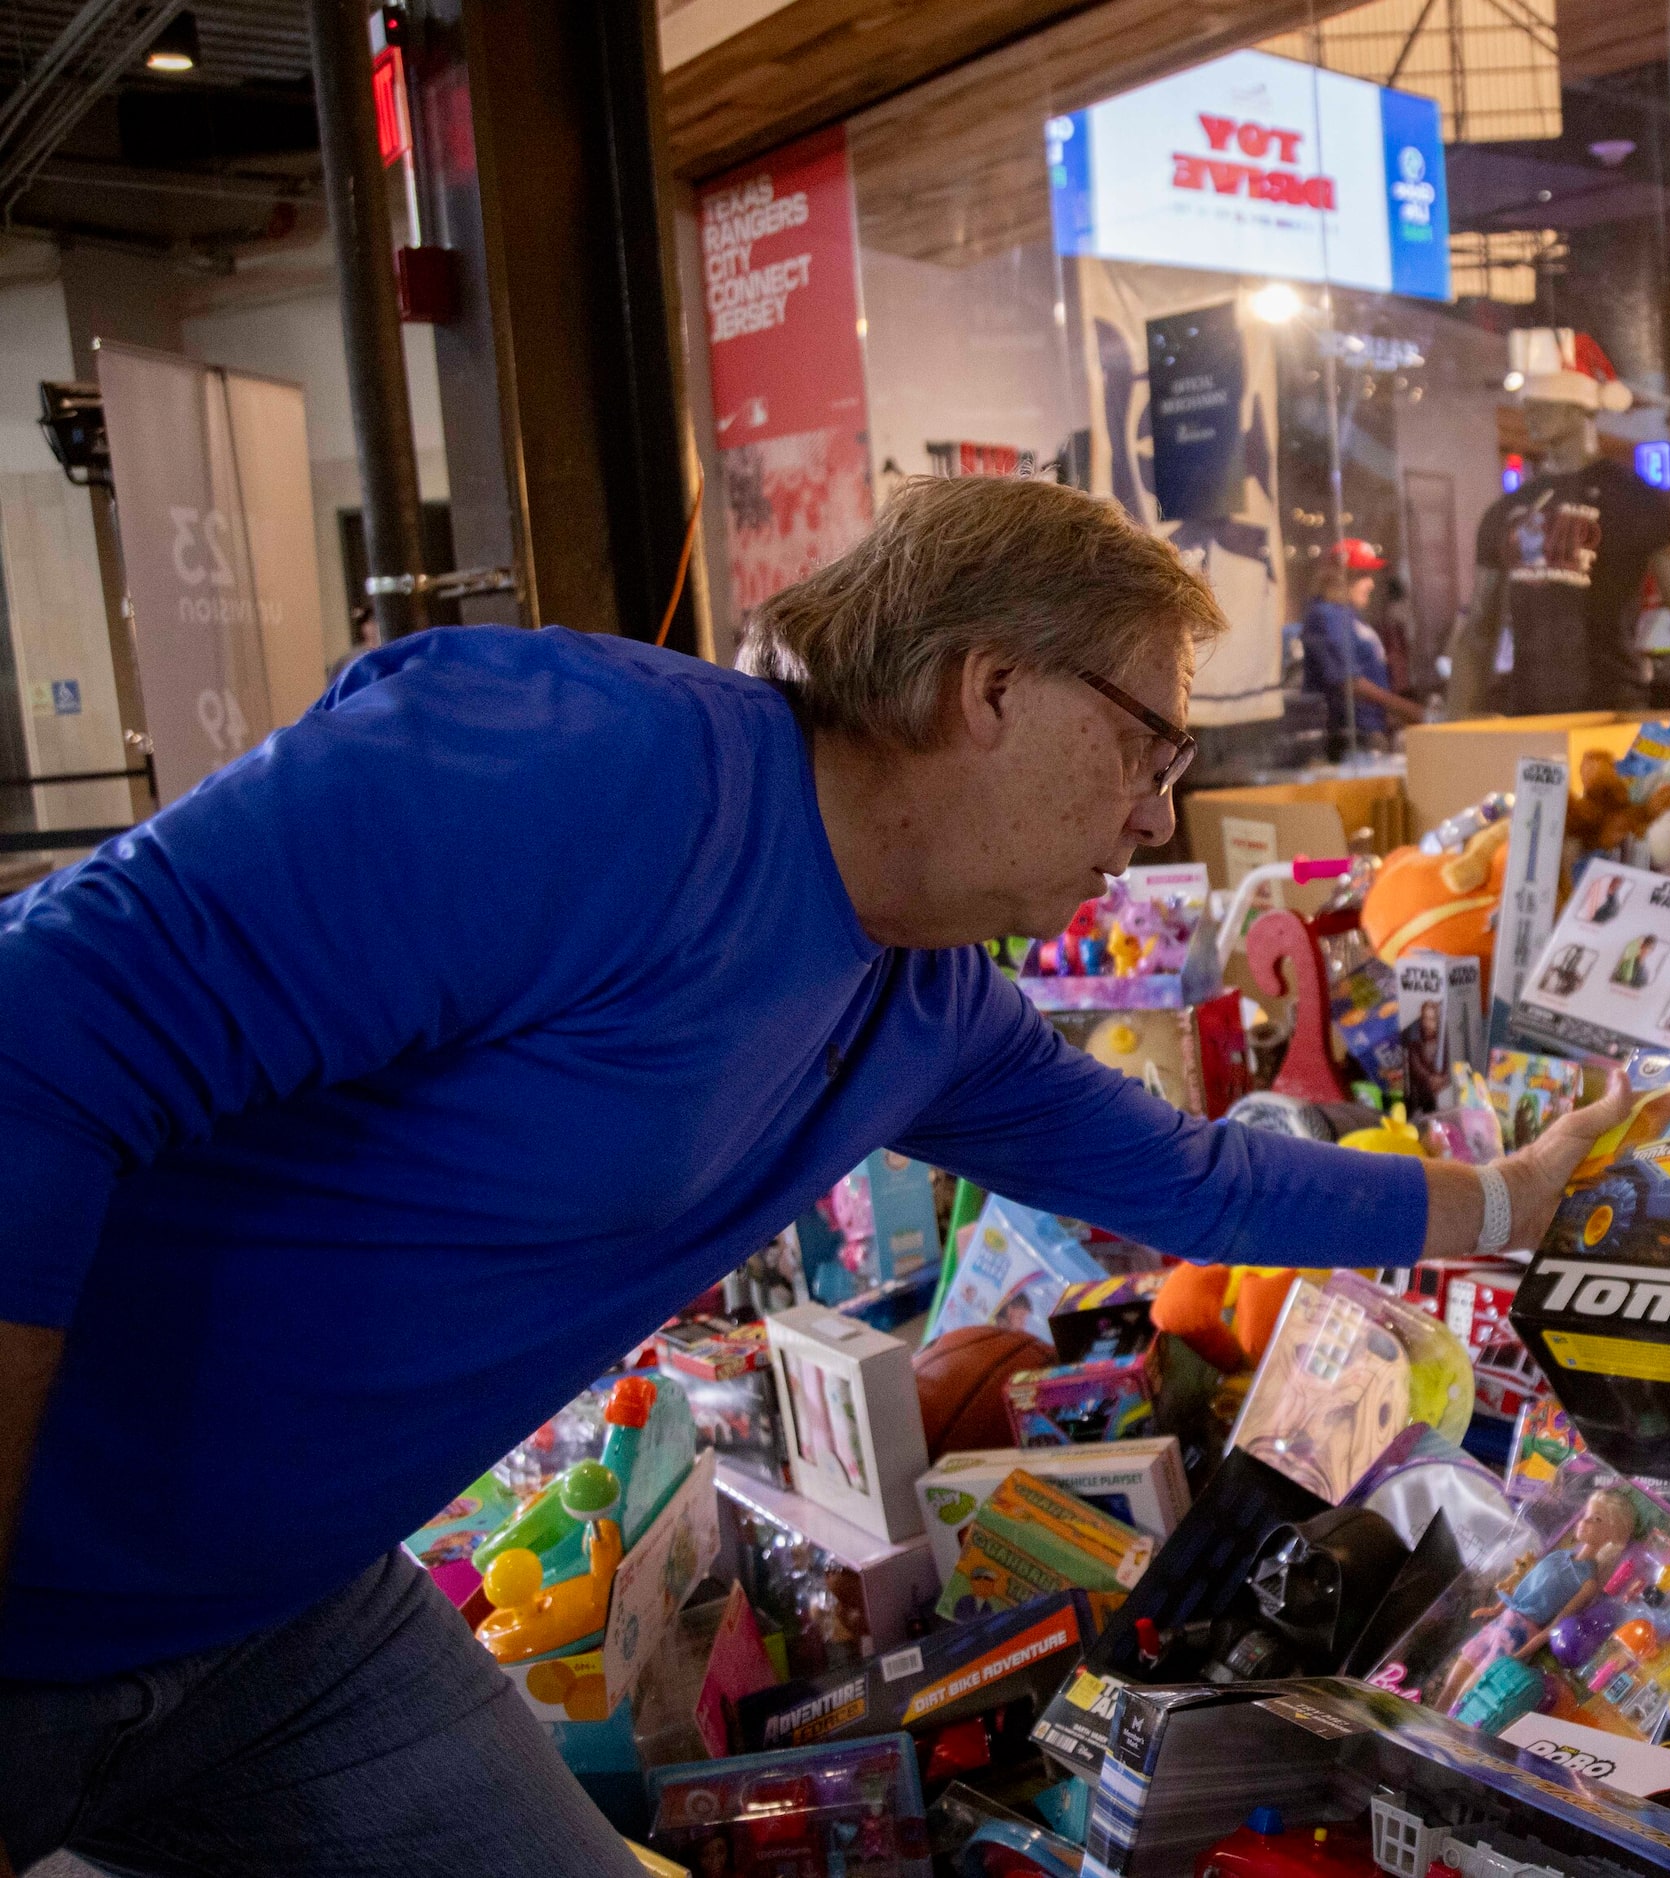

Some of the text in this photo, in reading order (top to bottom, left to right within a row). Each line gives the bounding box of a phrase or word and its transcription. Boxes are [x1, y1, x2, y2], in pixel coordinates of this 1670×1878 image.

[704, 192, 809, 250] RANGERS
[707, 245, 751, 284] CITY
[708, 253, 812, 312] CONNECT
[713, 294, 786, 342] JERSEY
[1400, 977, 1441, 993] WARS
[1405, 966, 1439, 980] STAR
[1101, 1472, 1143, 1486] PLAYSET
[914, 1629, 1068, 1714] DIRT BIKE ADVENTURE
[763, 1677, 866, 1748] ADVENTURE
[1123, 1728, 1145, 1745] Member's
